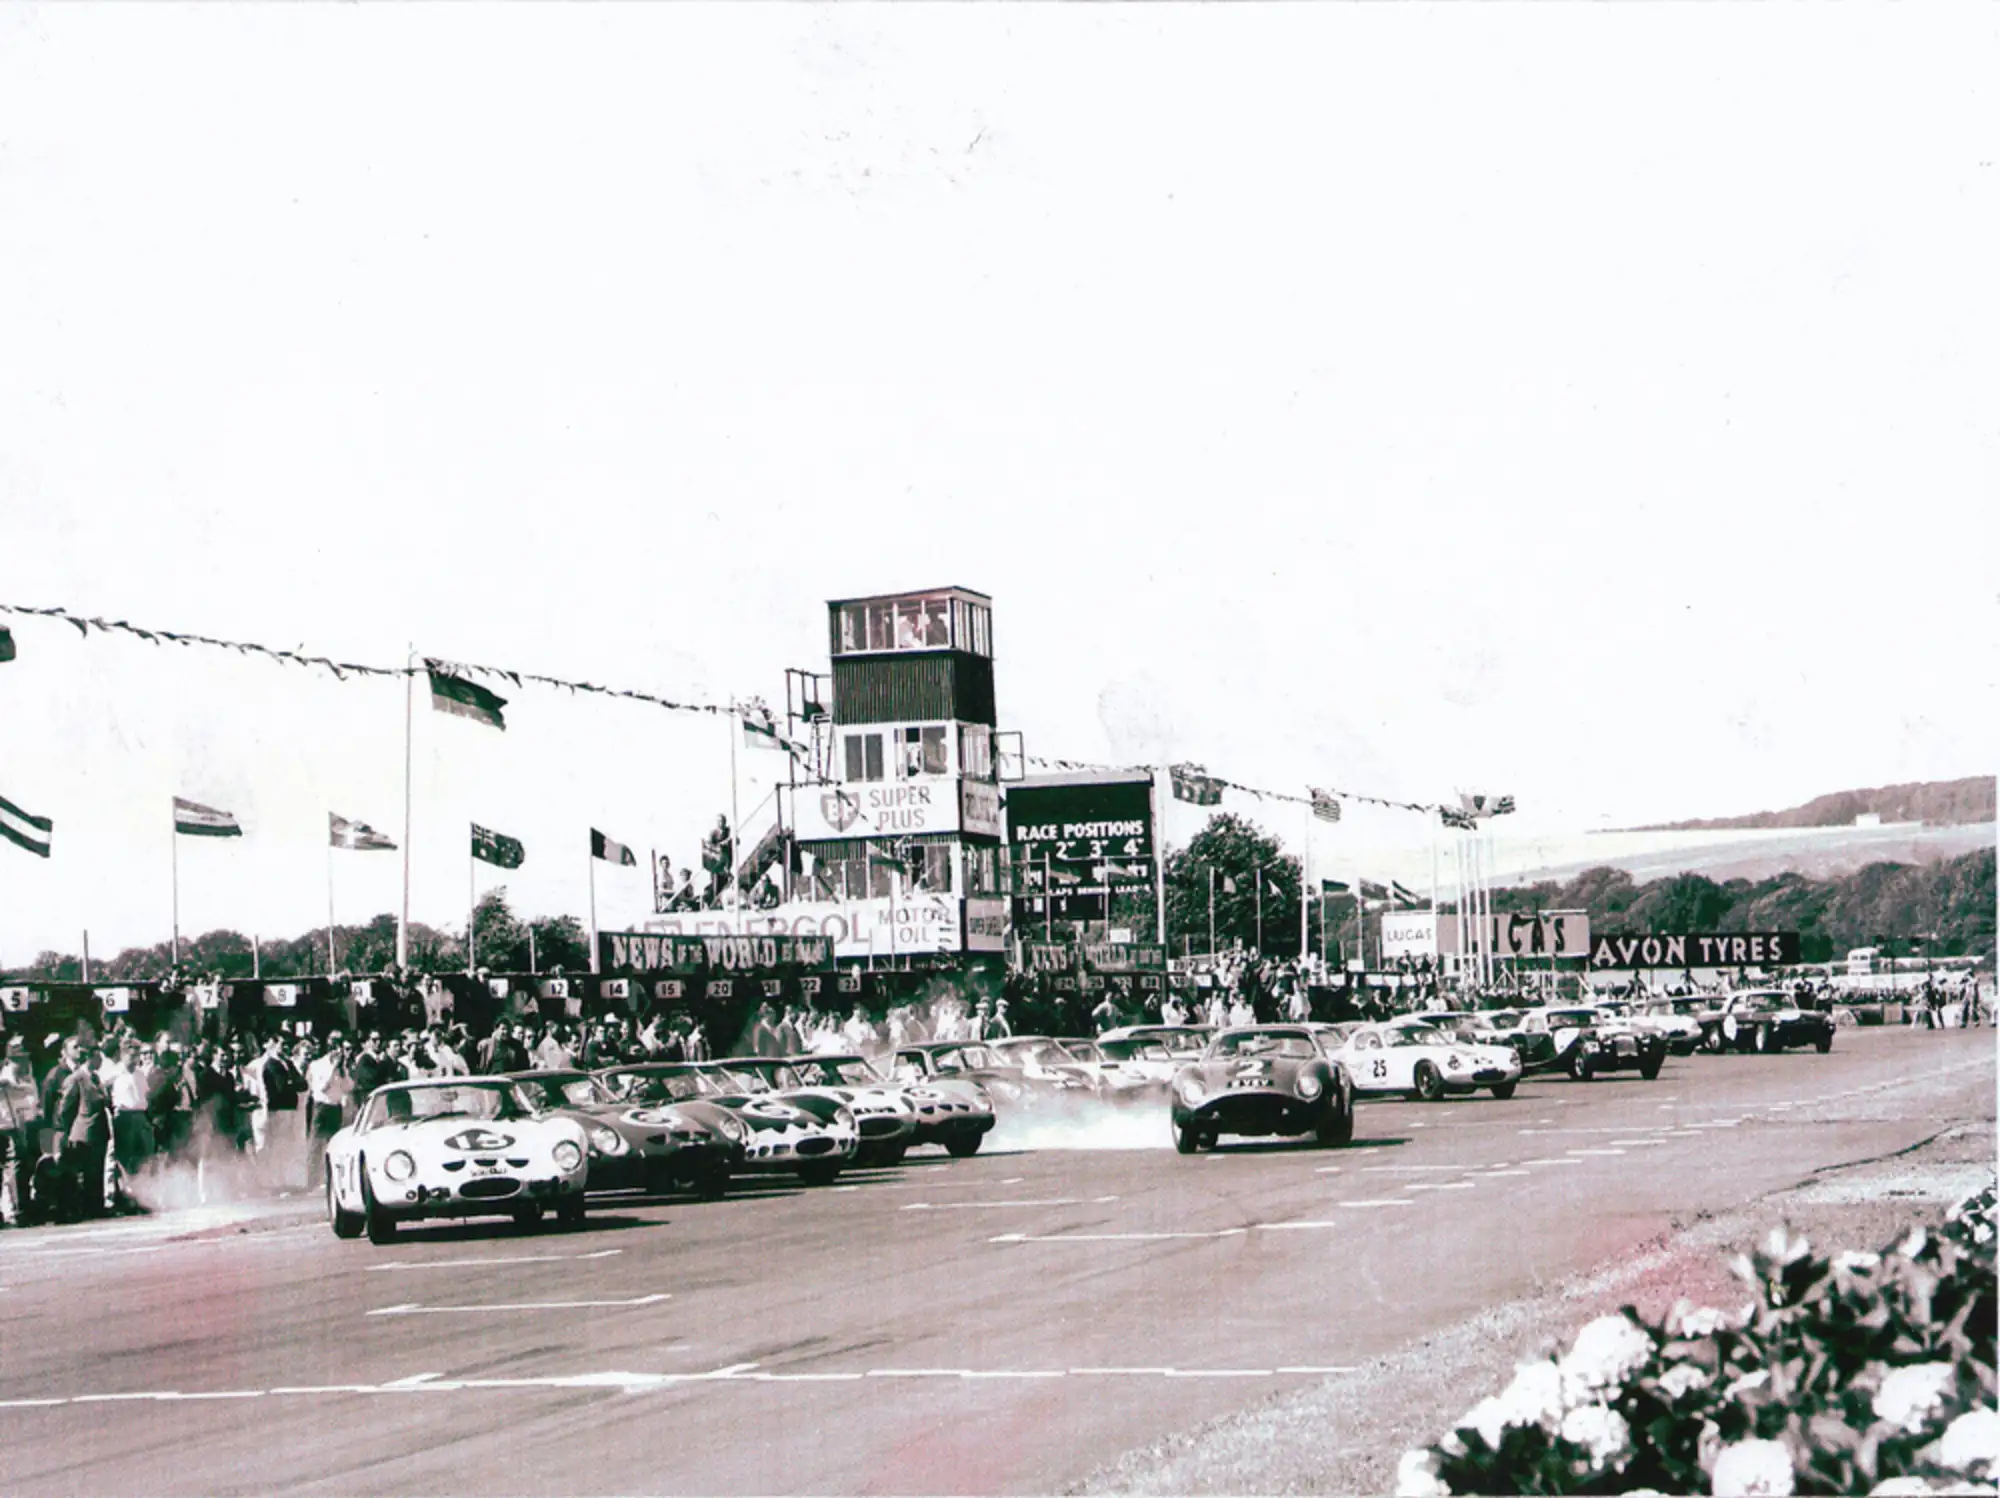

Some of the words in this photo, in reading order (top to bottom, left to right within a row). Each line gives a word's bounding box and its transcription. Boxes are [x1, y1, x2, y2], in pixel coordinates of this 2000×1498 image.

[868, 786, 932, 807] SUPER
[877, 808, 925, 829] PLUS
[1016, 825, 1057, 841] RACE
[1063, 820, 1144, 838] POSITIONS
[899, 927, 931, 943] OIL
[1387, 927, 1433, 942] LUCAS
[611, 934, 674, 969] NEWS
[703, 935, 777, 970] WORLD
[1592, 936, 1686, 967] AVON
[1699, 936, 1783, 963] TYRES
[551, 982, 564, 995] 12
[608, 983, 624, 996] 14
[661, 984, 674, 996] 15
[714, 981, 729, 995] 20
[803, 979, 817, 991] 22
[11, 990, 21, 1008] 5
[105, 993, 116, 1007] 6
[1373, 1059, 1387, 1078] 25
